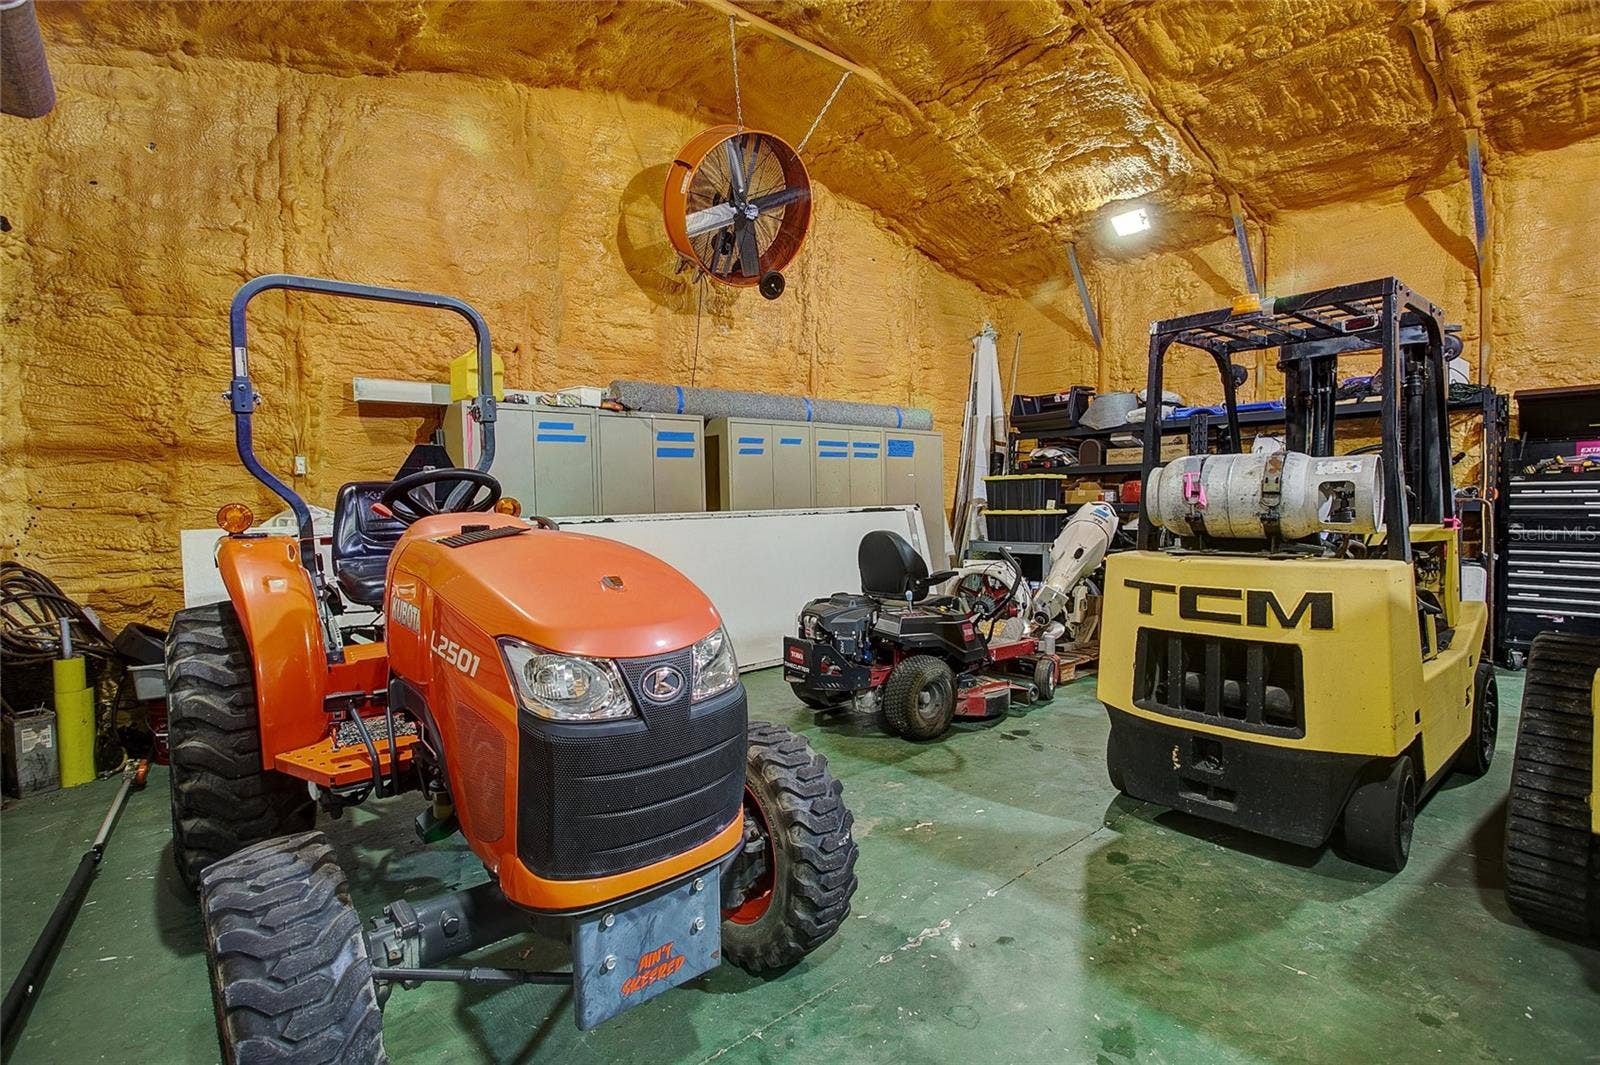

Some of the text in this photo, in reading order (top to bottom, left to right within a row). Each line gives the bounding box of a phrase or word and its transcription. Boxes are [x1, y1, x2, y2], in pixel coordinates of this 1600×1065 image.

[392, 596, 421, 635] KUBOTA
[1124, 579, 1334, 630] TCM
[430, 630, 480, 678] L2501
[637, 940, 675, 972] AIN'T
